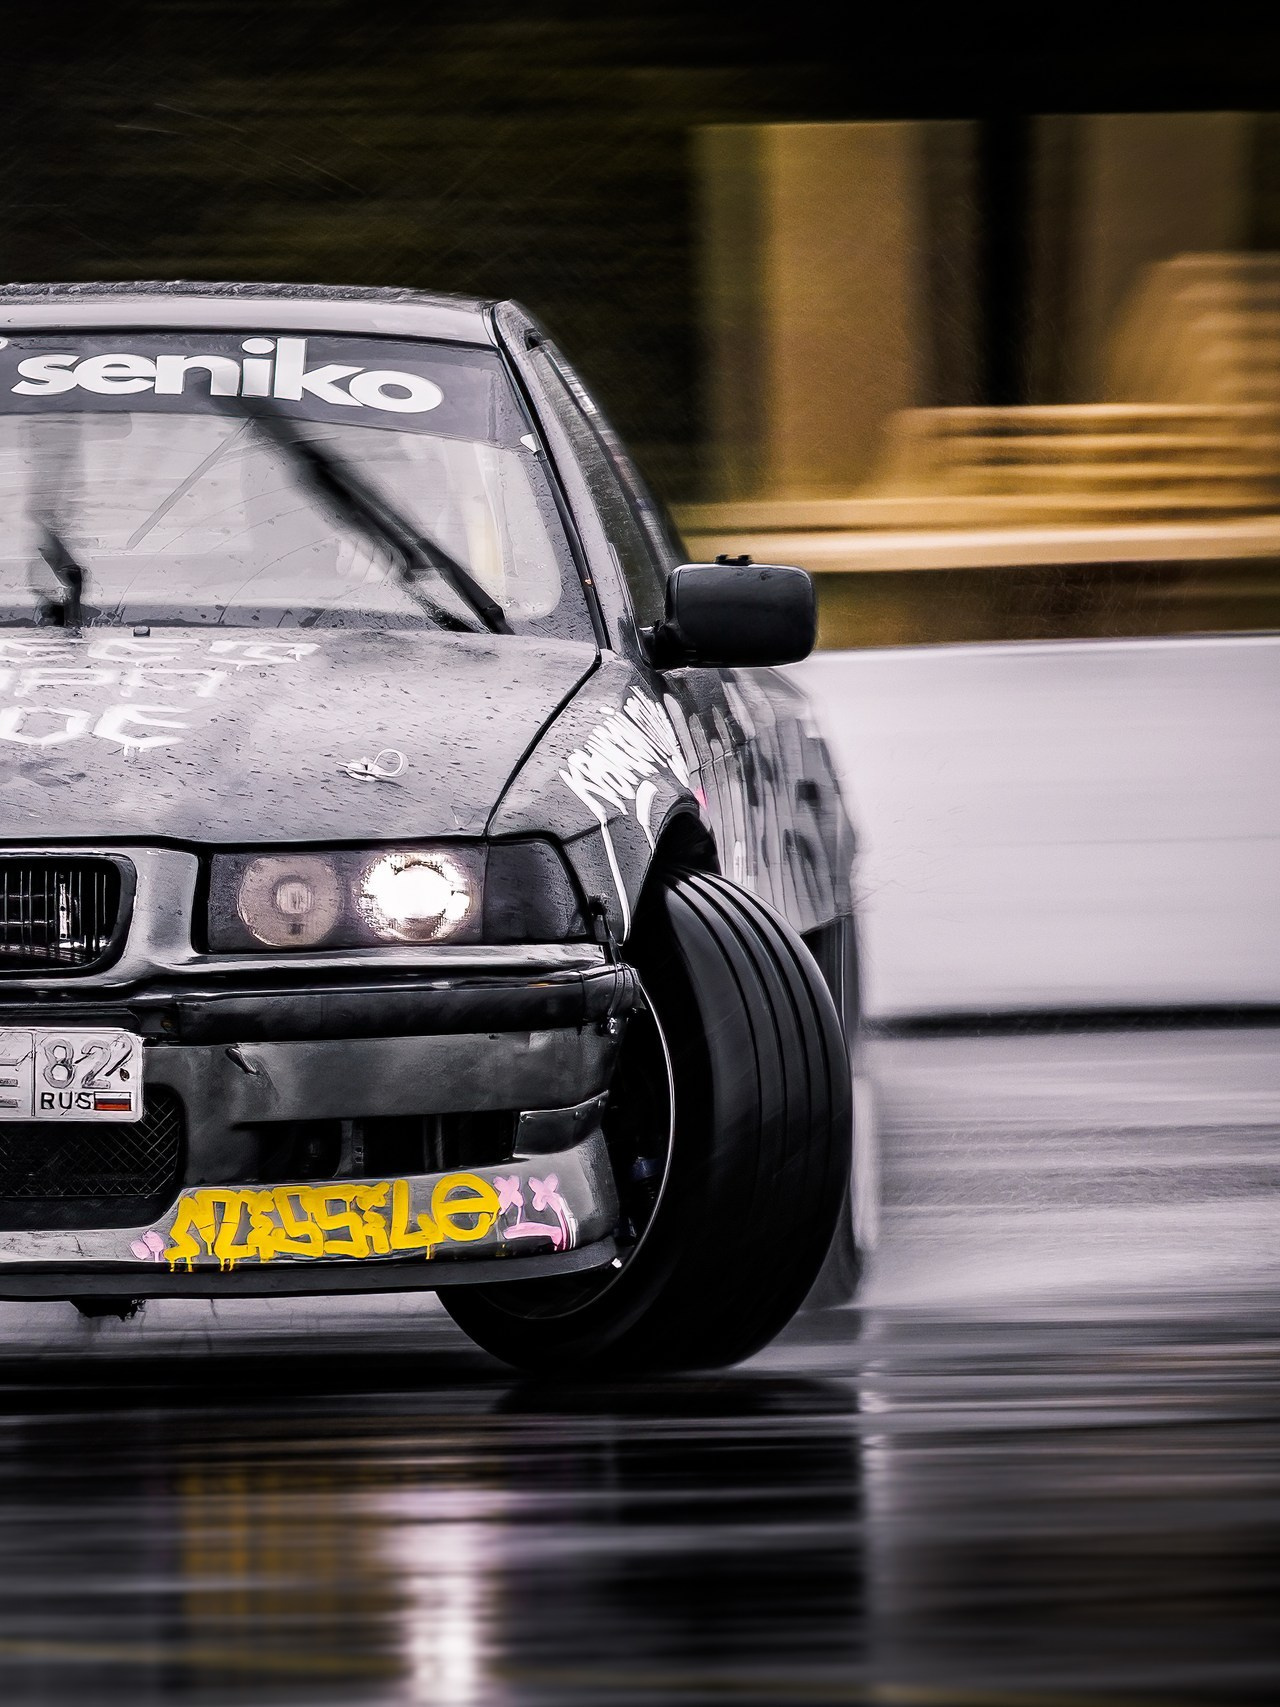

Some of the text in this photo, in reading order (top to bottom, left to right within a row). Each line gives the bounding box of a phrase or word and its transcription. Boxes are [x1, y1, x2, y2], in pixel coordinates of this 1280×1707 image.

[10, 337, 445, 413] seniko
[43, 1038, 111, 1089] 82
[40, 1091, 92, 1110] RUS
